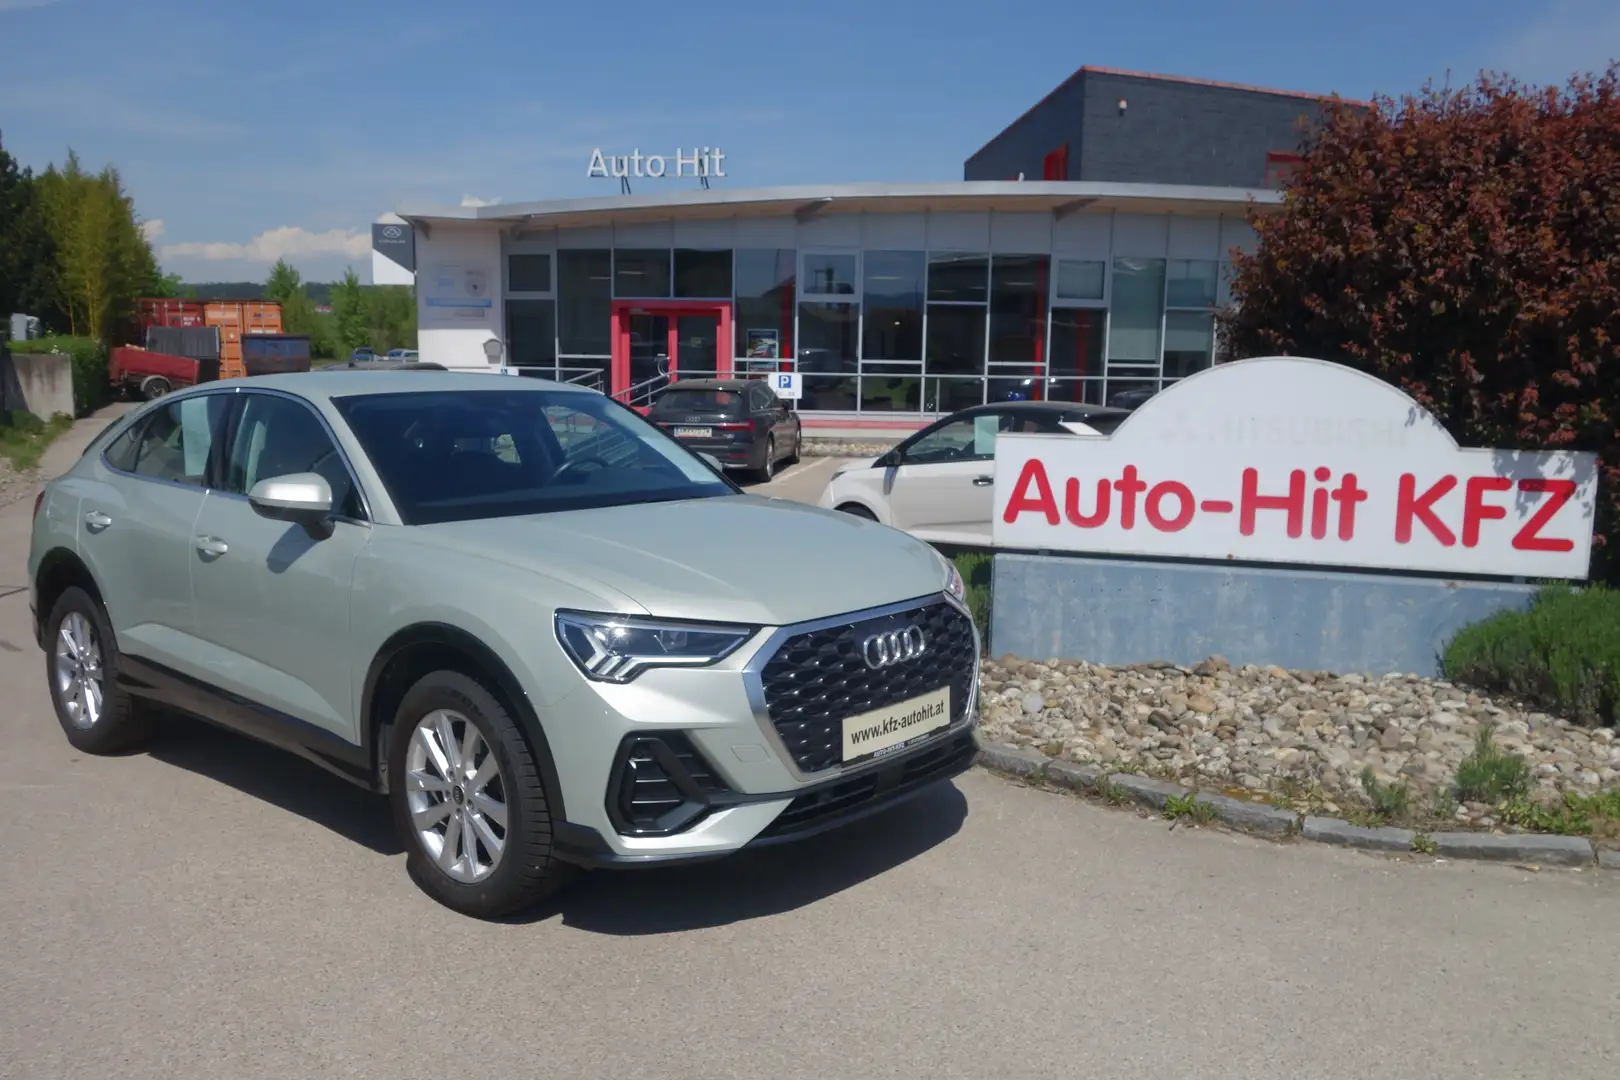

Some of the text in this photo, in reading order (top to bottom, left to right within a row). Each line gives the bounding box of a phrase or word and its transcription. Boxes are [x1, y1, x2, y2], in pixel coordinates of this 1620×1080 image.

[587, 146, 726, 177] Auto Hit
[781, 375, 790, 388] P
[1003, 458, 1576, 552] Auto-Hit KFZ
[851, 699, 944, 745] www.kfz-autohit.at
